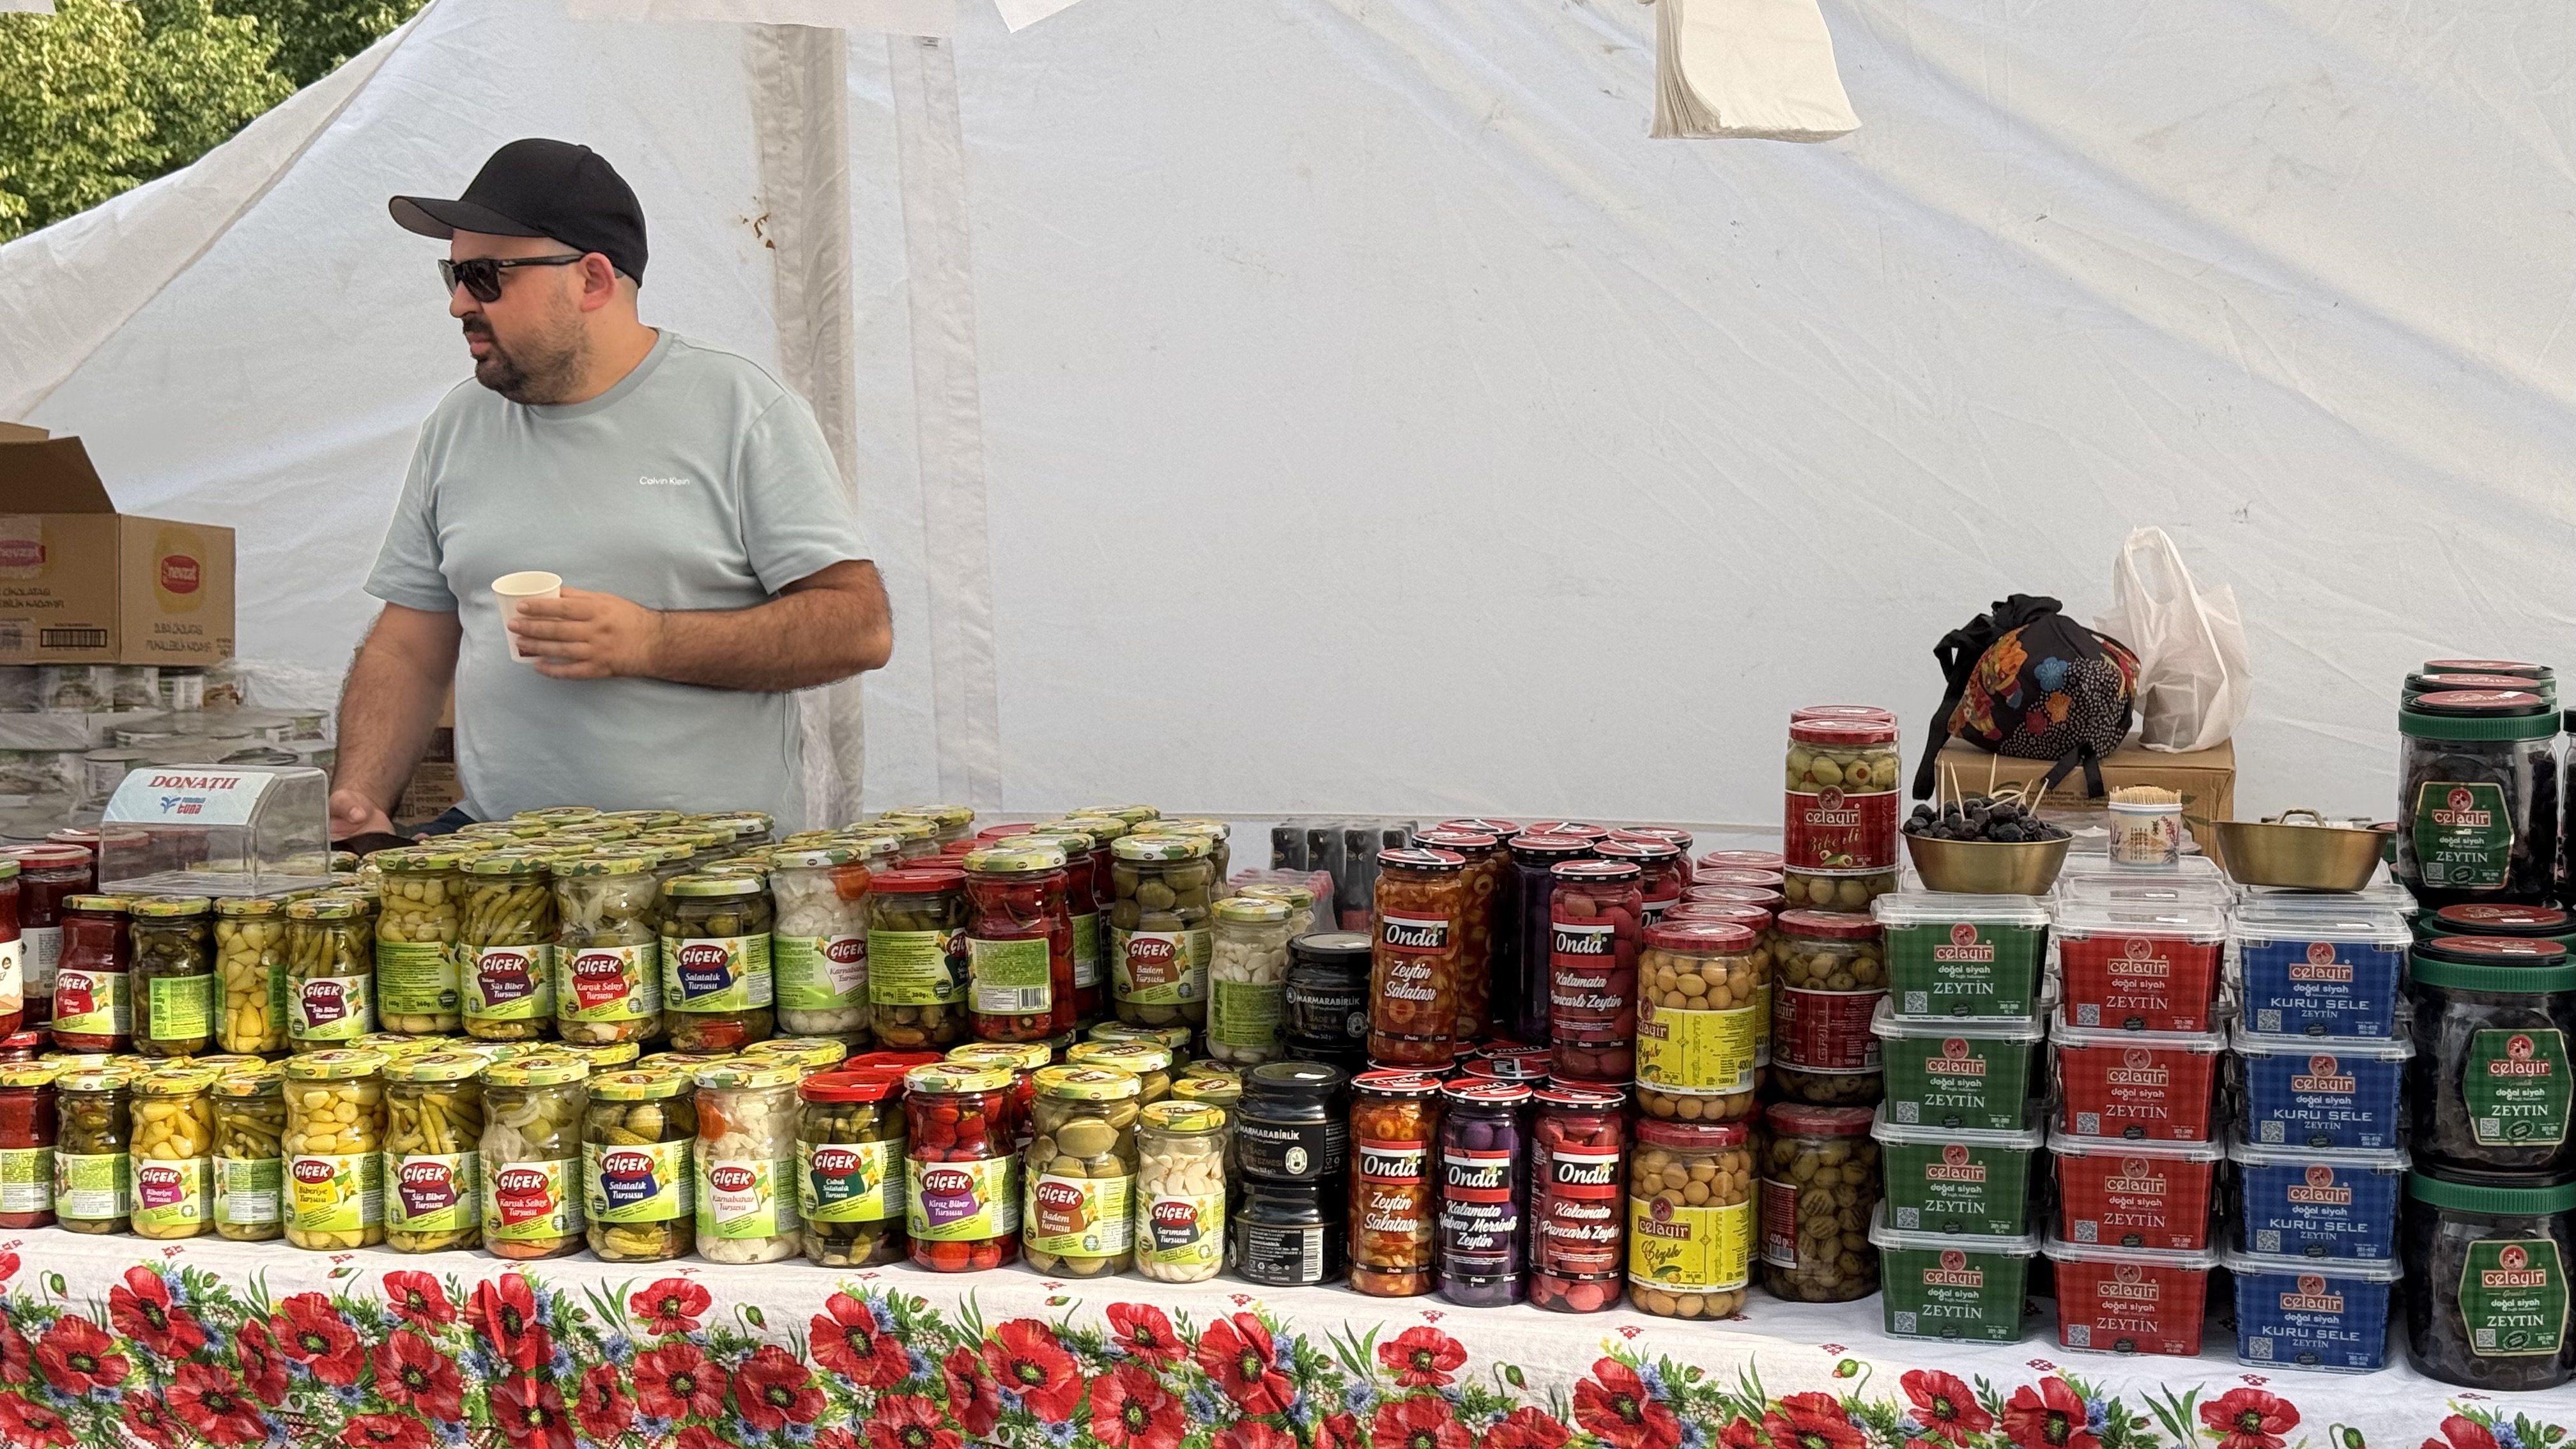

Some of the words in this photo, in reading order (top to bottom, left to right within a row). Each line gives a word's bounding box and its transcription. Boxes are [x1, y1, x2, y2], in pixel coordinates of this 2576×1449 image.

[639, 476, 668, 485] Calvin
[669, 477, 691, 486] Klein
[1641, 911, 1664, 928] On
[1385, 924, 1439, 947] Onda
[1556, 933, 1604, 954] Onda
[682, 947, 724, 966] ÇİÇEK
[829, 941, 865, 959] ÇİÇEK
[1130, 940, 1172, 960] ÇİÇEK
[482, 956, 526, 974] ÇİÇEK
[577, 956, 619, 976] ÇİÇEK
[1136, 965, 1164, 975] Badem
[1390, 960, 1432, 981] Zeytin
[1938, 965, 1963, 978] doğal
[1965, 965, 1991, 974] siyah
[58, 974, 91, 991] ÇİÇEK
[490, 982, 503, 991] Süs
[505, 982, 525, 990] Biber
[1554, 971, 1608, 989] Kalamata
[2140, 979, 2165, 989] siyah
[306, 985, 341, 998] ÇİÇEK
[2322, 984, 2349, 994] siyah
[1586, 993, 1623, 1012] Zeytin
[2271, 997, 2318, 1009] KURU
[2325, 999, 2370, 1011] SELE
[1957, 1078, 1982, 1088] siyah
[2139, 1088, 2165, 1098] siyah
[2325, 1096, 2352, 1105] siyah
[2522, 1088, 2545, 1098] siyah
[2273, 1108, 2320, 1120] KURU
[2327, 1111, 2373, 1122] SELE
[1239, 1124, 1301, 1141] MARMARABİRLİK
[294, 1162, 332, 1179] ÇİÇEK
[605, 1154, 651, 1174] ÇİÇEK
[814, 1152, 858, 1172] ÇİÇEK
[1363, 1154, 1419, 1177] Onda
[142, 1168, 179, 1186] ÇİÇEK
[403, 1165, 448, 1184] ÇİÇEK
[499, 1172, 544, 1191] ÇİÇEK
[712, 1170, 752, 1187] ÇİÇEK
[926, 1172, 970, 1192] ÇİÇEK
[1448, 1165, 1499, 1188] Onda
[1558, 1163, 1612, 1184] Onda
[411, 1192, 425, 1202] Süs
[425, 1192, 448, 1201] Biber
[1038, 1184, 1082, 1206] ÇİÇEK
[1958, 1184, 1982, 1193] siyah
[948, 1199, 970, 1208] Biber
[1370, 1191, 1413, 1215] Zeytin
[1446, 1200, 1502, 1218] Kalamata
[1553, 1201, 1612, 1220] Kalamata
[2320, 1206, 2347, 1216] siyah
[1041, 1210, 1071, 1224] Badem
[1154, 1203, 1195, 1221] ÇİÇEK
[2269, 1218, 2317, 1230] KURU
[2324, 1221, 2368, 1233] SELE
[1456, 1231, 1494, 1250] Zeytin
[1768, 1232, 1782, 1244] 400
[1954, 1289, 1979, 1299] siyah
[2517, 1298, 2540, 1308] siyah
[2313, 1314, 2340, 1325] siyah
[2262, 1326, 2309, 1338] KURU
[2315, 1330, 2361, 1342] SELE
